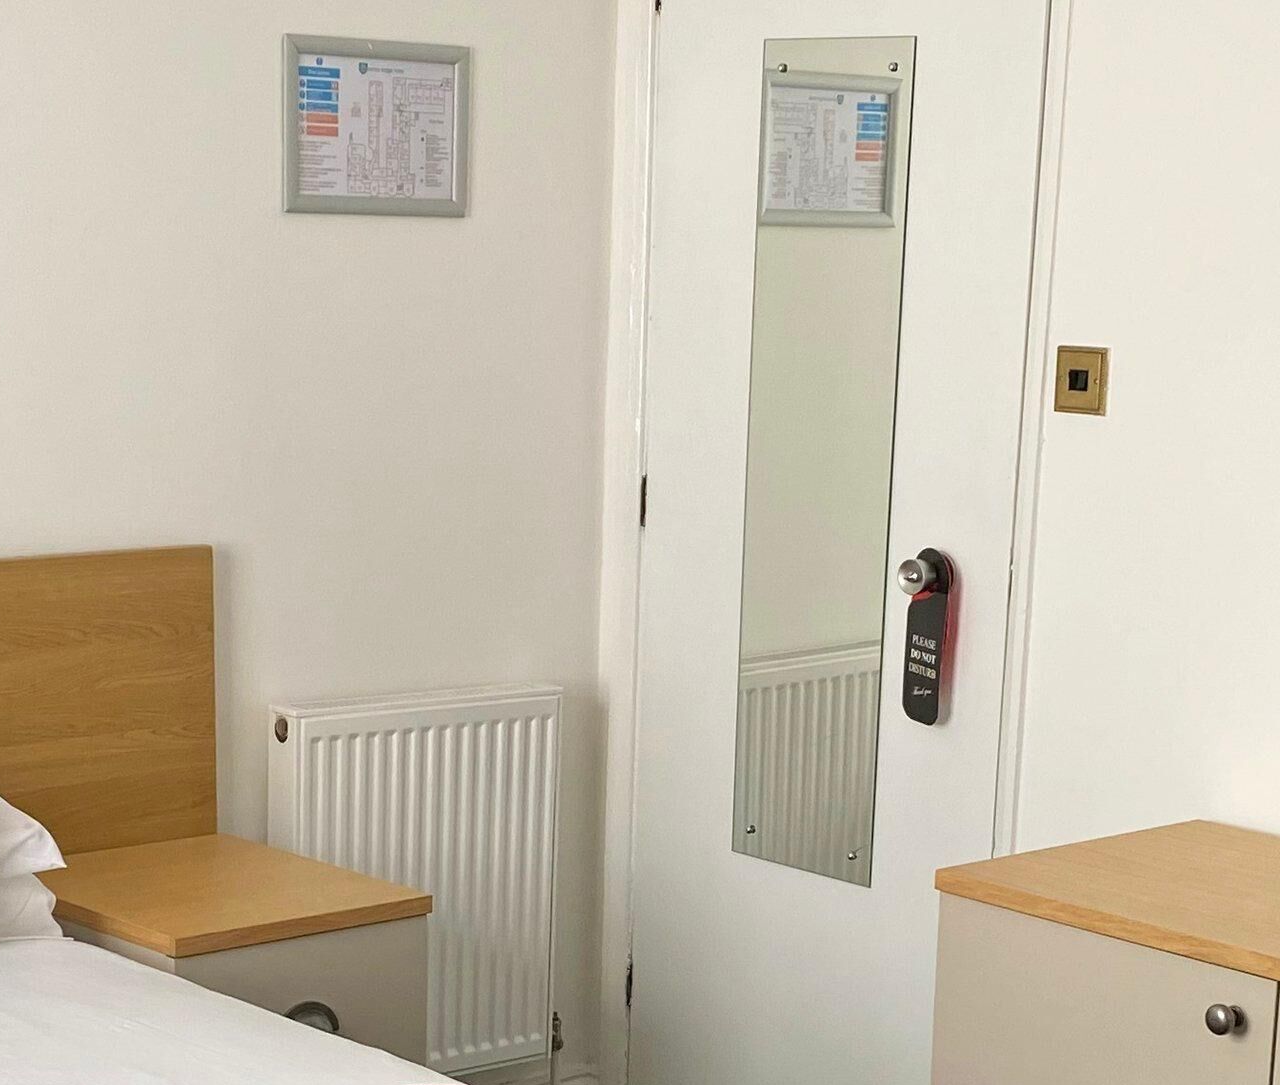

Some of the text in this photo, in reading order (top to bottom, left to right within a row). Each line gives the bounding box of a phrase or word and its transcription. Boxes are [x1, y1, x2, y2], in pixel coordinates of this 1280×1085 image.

[912, 634, 937, 650] PLEASE
[910, 648, 936, 665] DO NOT
[908, 661, 936, 679] DISTURB
